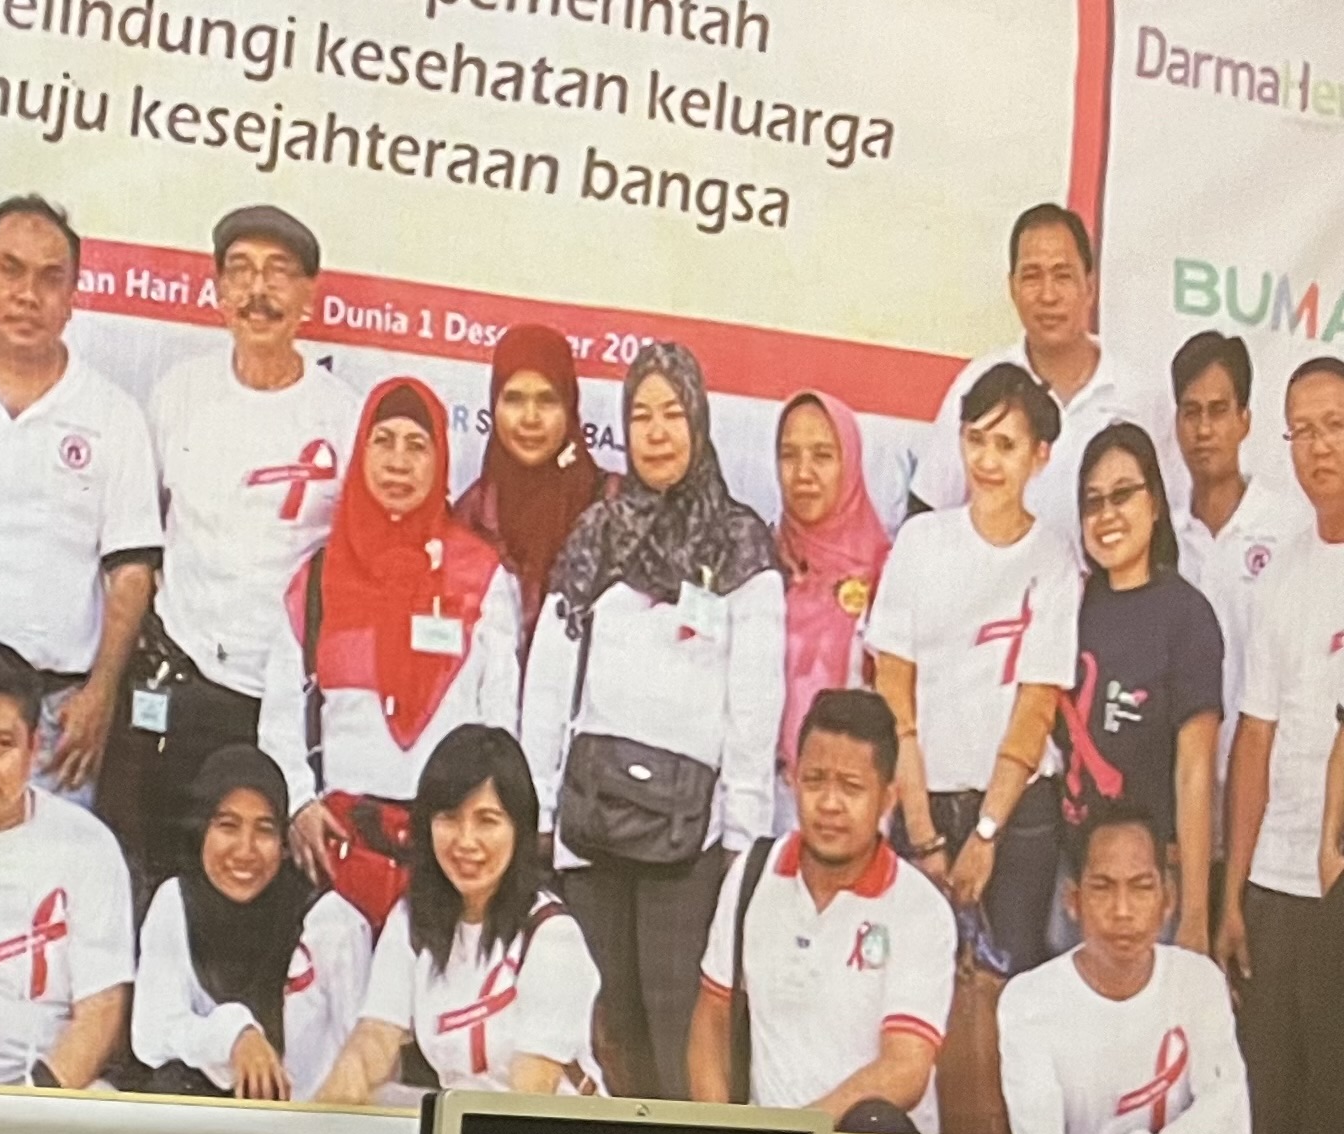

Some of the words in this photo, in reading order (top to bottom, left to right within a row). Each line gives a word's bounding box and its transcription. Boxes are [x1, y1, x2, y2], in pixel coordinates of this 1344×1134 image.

[315, 21, 629, 115] kesehatan
[647, 69, 895, 169] keluarga
[1135, 25, 1344, 120] DarmaHe
[130, 84, 560, 196] kesejahteraan
[581, 146, 791, 235] bangsa
[125, 267, 190, 304] Hari
[322, 295, 409, 335] Dunia
[417, 311, 433, 340] 1
